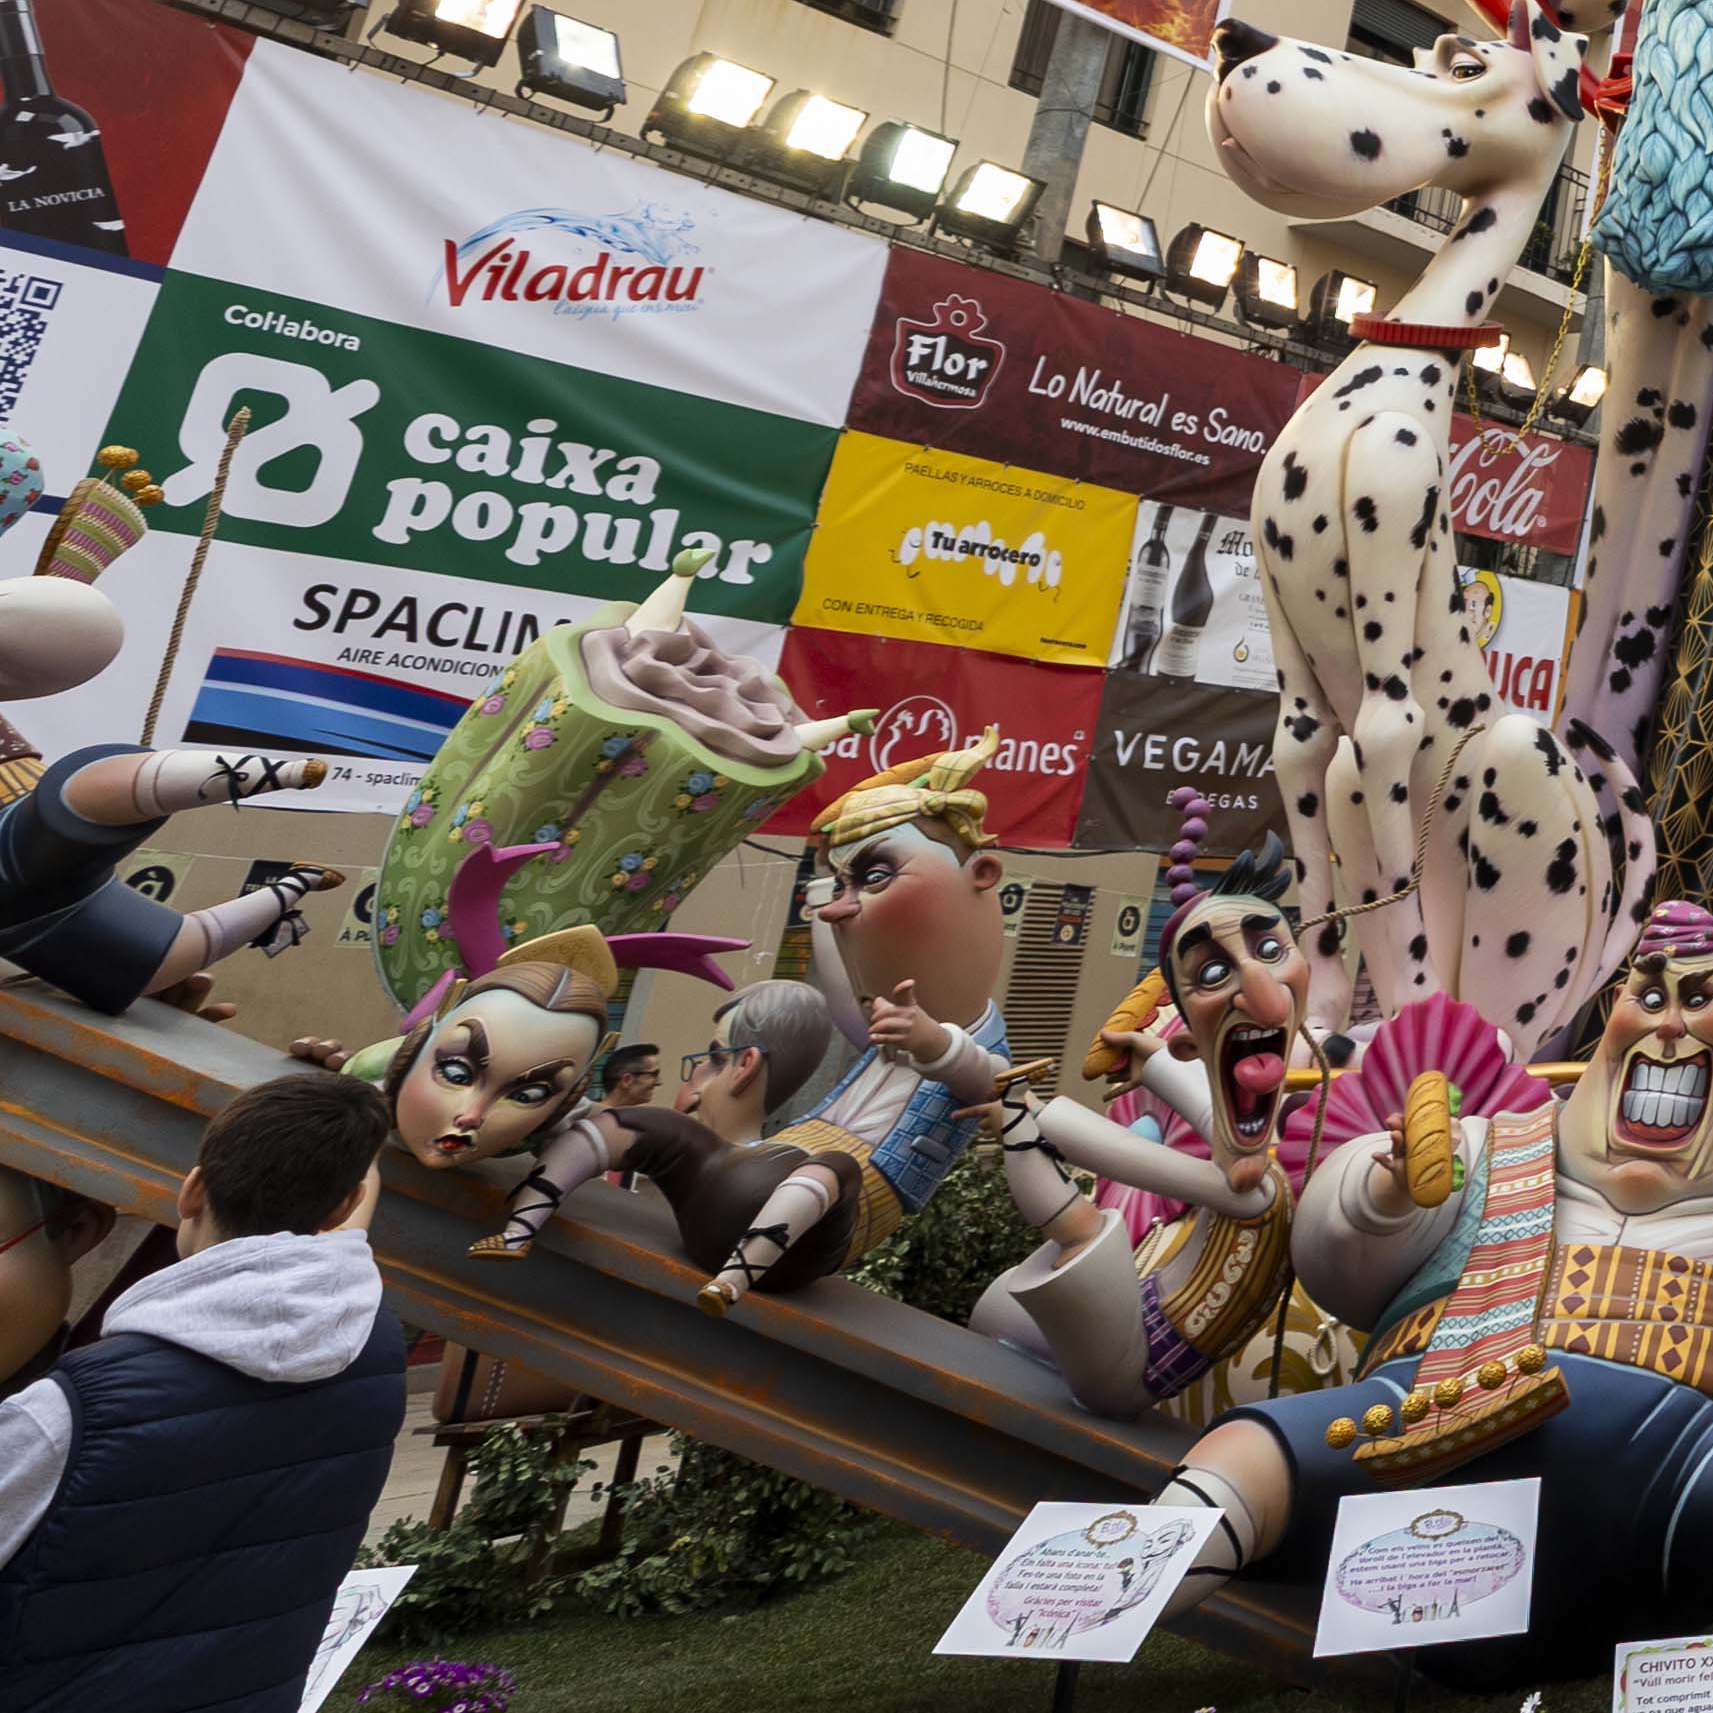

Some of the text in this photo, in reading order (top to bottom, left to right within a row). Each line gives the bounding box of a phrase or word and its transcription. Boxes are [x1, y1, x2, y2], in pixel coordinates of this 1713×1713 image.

[8, 187, 105, 213] LA NOVICIA
[443, 237, 705, 306] Viladrau
[907, 333, 988, 382] Flor
[906, 370, 977, 398] Villahermosa
[1028, 355, 1267, 455] Lo Natural es Sano.
[403, 412, 663, 505] caixa
[1060, 416, 1210, 466] www.embutidosflor.es
[903, 462, 959, 484] PAELLAS
[967, 475, 1022, 497] ARROCES
[1023, 488, 1033, 498] A
[1033, 489, 1086, 511] DOMICILIO
[931, 530, 1041, 567] Tu arrocero
[822, 597, 852, 614] CON
[855, 602, 914, 621] ENTREGA
[925, 612, 985, 632] RECOGIDA
[337, 647, 504, 679] AIRE ACONDICION
[1114, 730, 1278, 778] VEGAMA
[1166, 790, 1258, 810] BEGAS
[1640, 1658, 1696, 1674] CHIVITO
[1665, 1674, 1695, 1685] morir
[1636, 1696, 1654, 1706] Tot
[1657, 1691, 1711, 1705] comprimit
